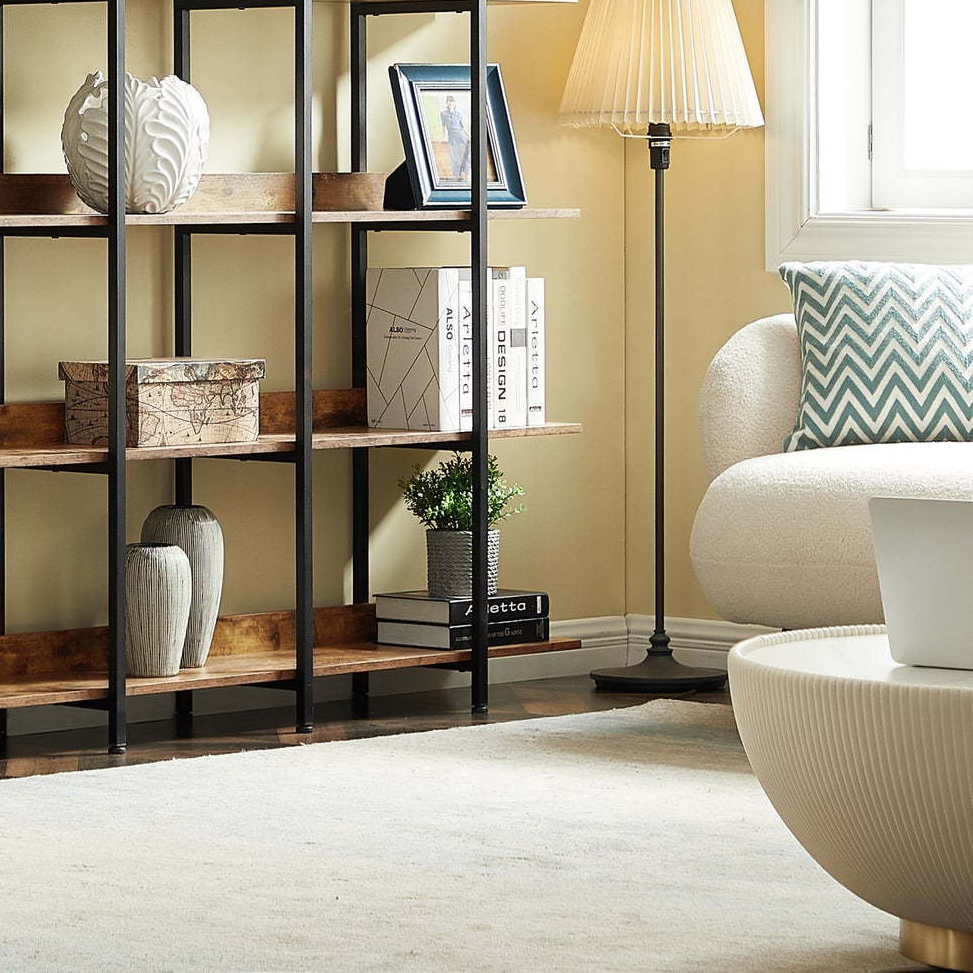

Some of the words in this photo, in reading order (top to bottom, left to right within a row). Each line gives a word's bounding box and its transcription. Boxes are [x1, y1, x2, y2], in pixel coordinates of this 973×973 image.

[462, 306, 472, 395] Arletta
[497, 330, 506, 400] DESIGN
[531, 300, 539, 389] Arletta
[498, 408, 506, 423] 18
[465, 601, 526, 616] Aletta
